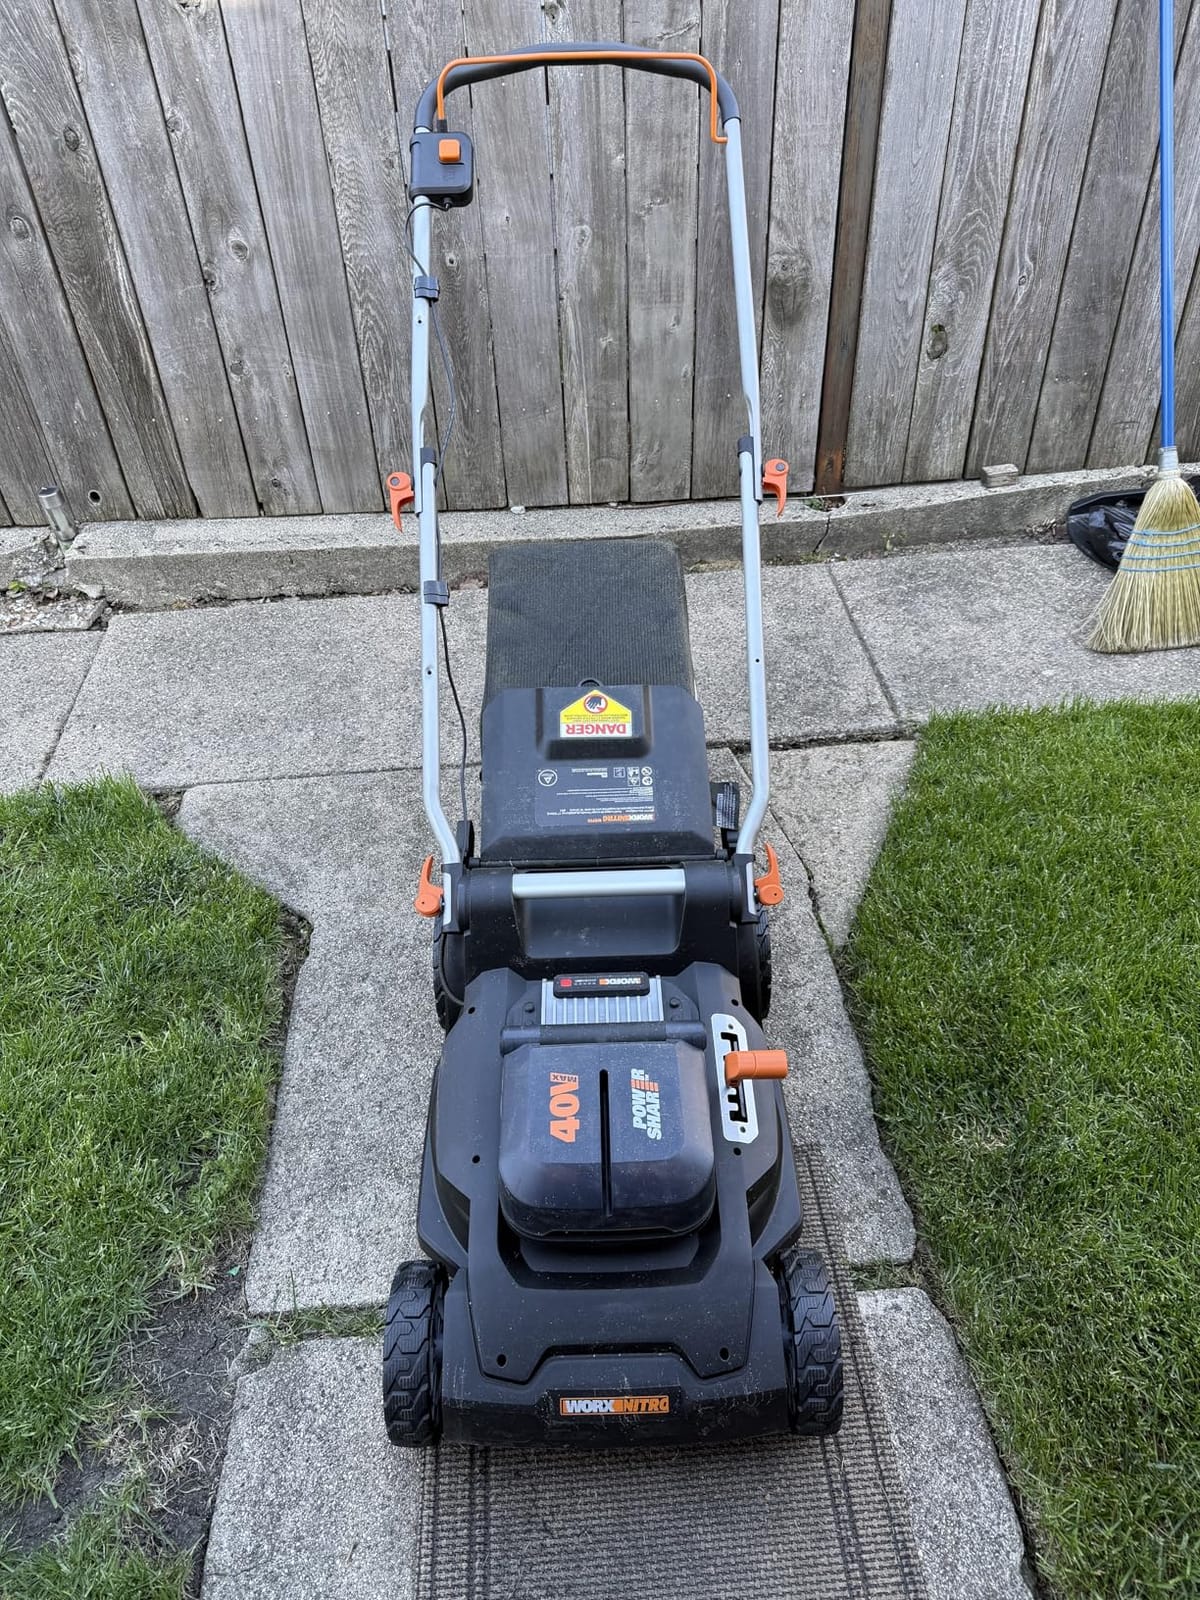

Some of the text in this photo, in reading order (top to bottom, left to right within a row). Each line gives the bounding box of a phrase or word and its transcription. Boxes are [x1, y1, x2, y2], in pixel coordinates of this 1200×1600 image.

[566, 724, 626, 735] DANGER
[551, 1073, 577, 1082] MAX
[549, 1081, 580, 1143] 40V
[631, 1068, 646, 1130] POWER
[644, 1082, 662, 1141] SHARE
[566, 1398, 669, 1413] WORX NITRO
